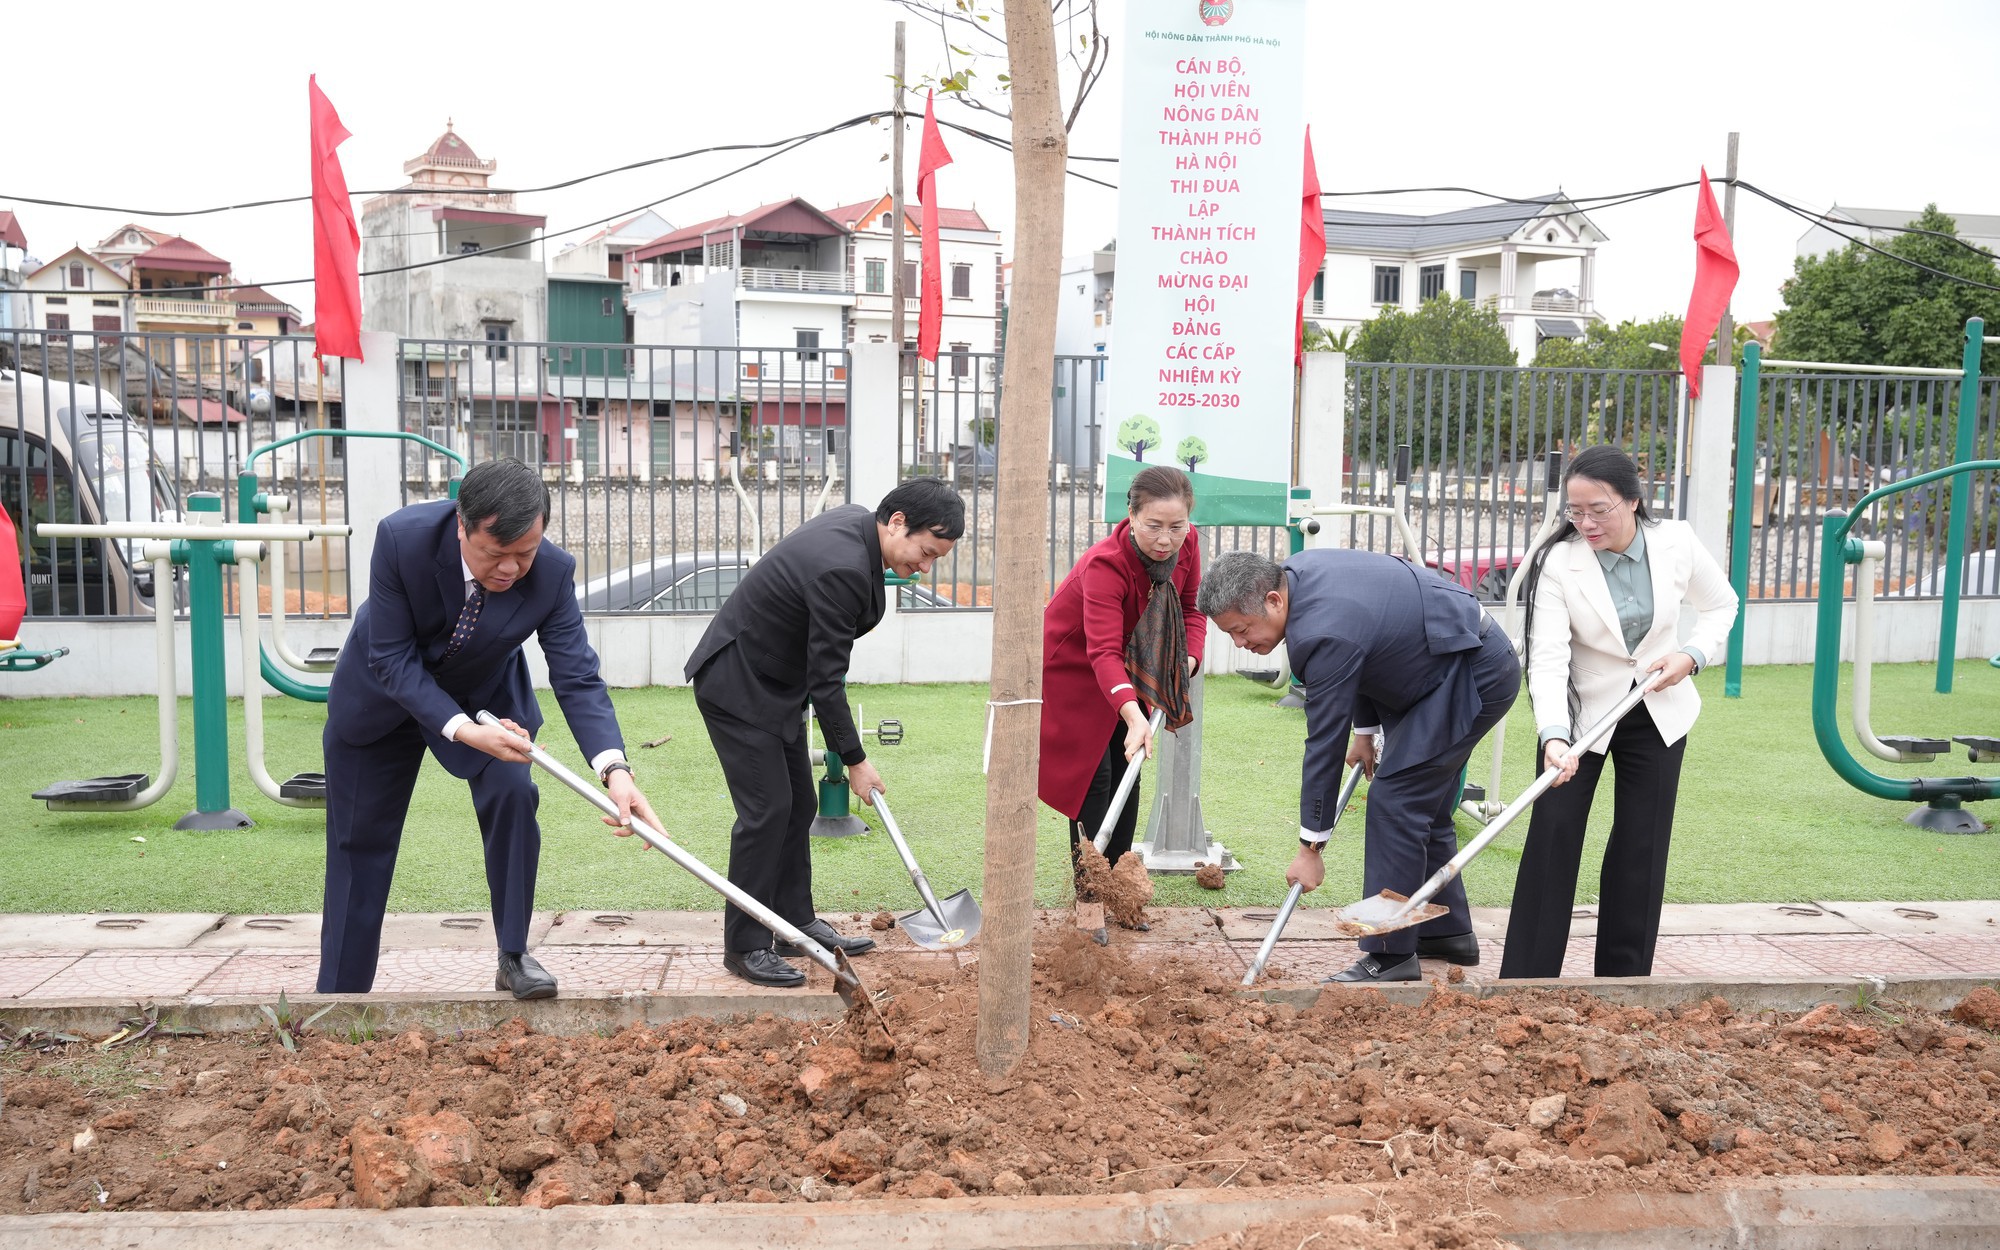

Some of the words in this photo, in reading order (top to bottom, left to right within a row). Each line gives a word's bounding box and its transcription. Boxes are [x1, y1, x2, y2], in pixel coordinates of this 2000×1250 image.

[1145, 30, 1160, 40] HỘI
[1161, 32, 1185, 41] NÔNG
[1186, 34, 1203, 42] DÂN
[1205, 34, 1233, 42] THÀNH
[1266, 39, 1281, 48] NỘI
[1175, 57, 1211, 75] CÁN
[1217, 56, 1246, 77] BỘ,
[1174, 81, 1205, 102] HỘI
[1211, 80, 1250, 98] VIÊN
[1163, 104, 1215, 122] NÔNG
[1221, 104, 1259, 122] DÂN
[1159, 128, 1219, 146] THÀNH
[1224, 128, 1262, 146] PHỐ
[1175, 152, 1200, 170] HÀ
[1205, 151, 1237, 172] NỘI
[1170, 180, 1198, 194] THI
[1203, 179, 1241, 193] ĐUA
[1188, 199, 1220, 221] LẬP
[1151, 224, 1212, 241] THÀNH
[1216, 223, 1256, 241] TÍCH
[1180, 247, 1229, 265] CHÀO
[1158, 270, 1214, 289] MỪNG
[1218, 275, 1249, 292] ĐẠI
[1184, 294, 1215, 316] HỘI
[1172, 317, 1222, 336] ĐẢNG
[1165, 342, 1198, 360] CÁC
[1202, 342, 1236, 360] CẤP
[1159, 366, 1215, 387] NHIỆM
[1219, 367, 1242, 384] KỲ
[1158, 392, 1241, 408] 2025-2030
[31, 573, 52, 585] OUNT
